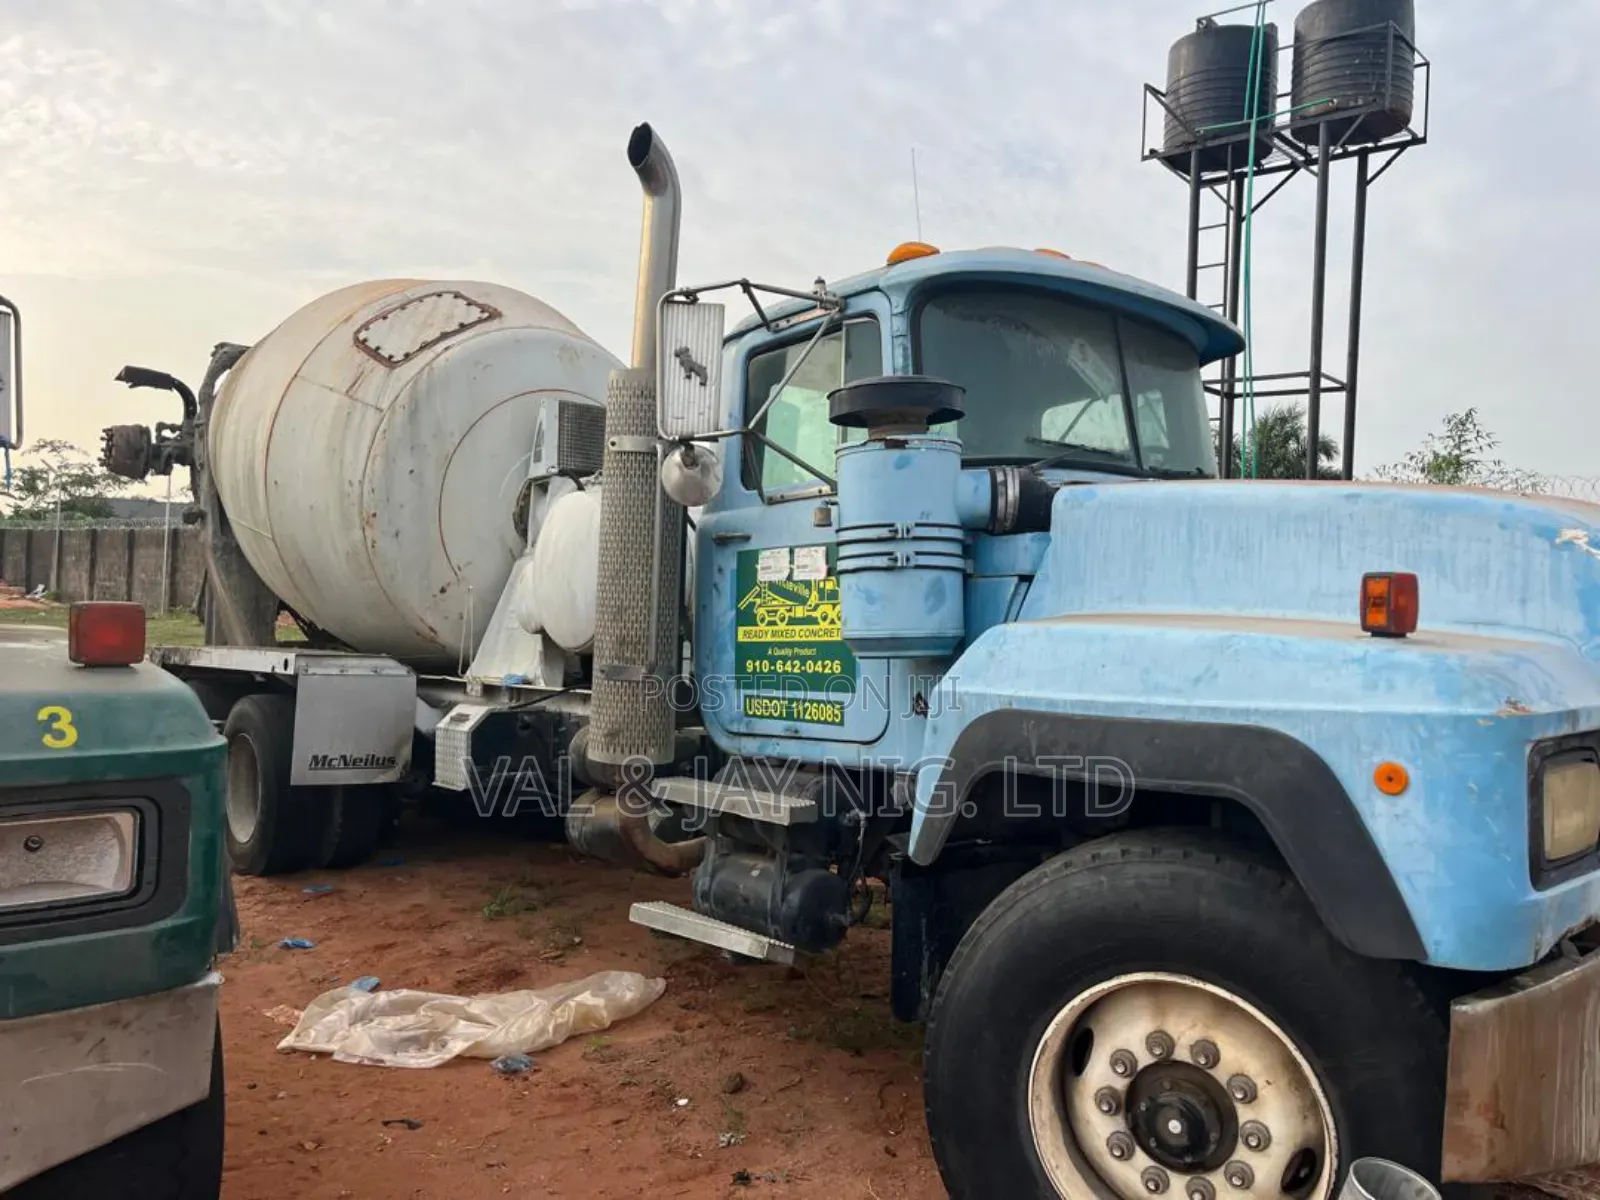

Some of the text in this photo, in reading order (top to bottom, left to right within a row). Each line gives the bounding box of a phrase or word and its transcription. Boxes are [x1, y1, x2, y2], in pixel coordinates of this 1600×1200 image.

[743, 627, 841, 639] READY MIXED CONCRET
[773, 647, 792, 657] Quality
[793, 647, 817, 655] Product
[746, 660, 842, 674] 910-642-0426
[746, 697, 842, 722] USDOT 1126085
[37, 706, 78, 748] 3
[308, 754, 397, 770] McNeilus
